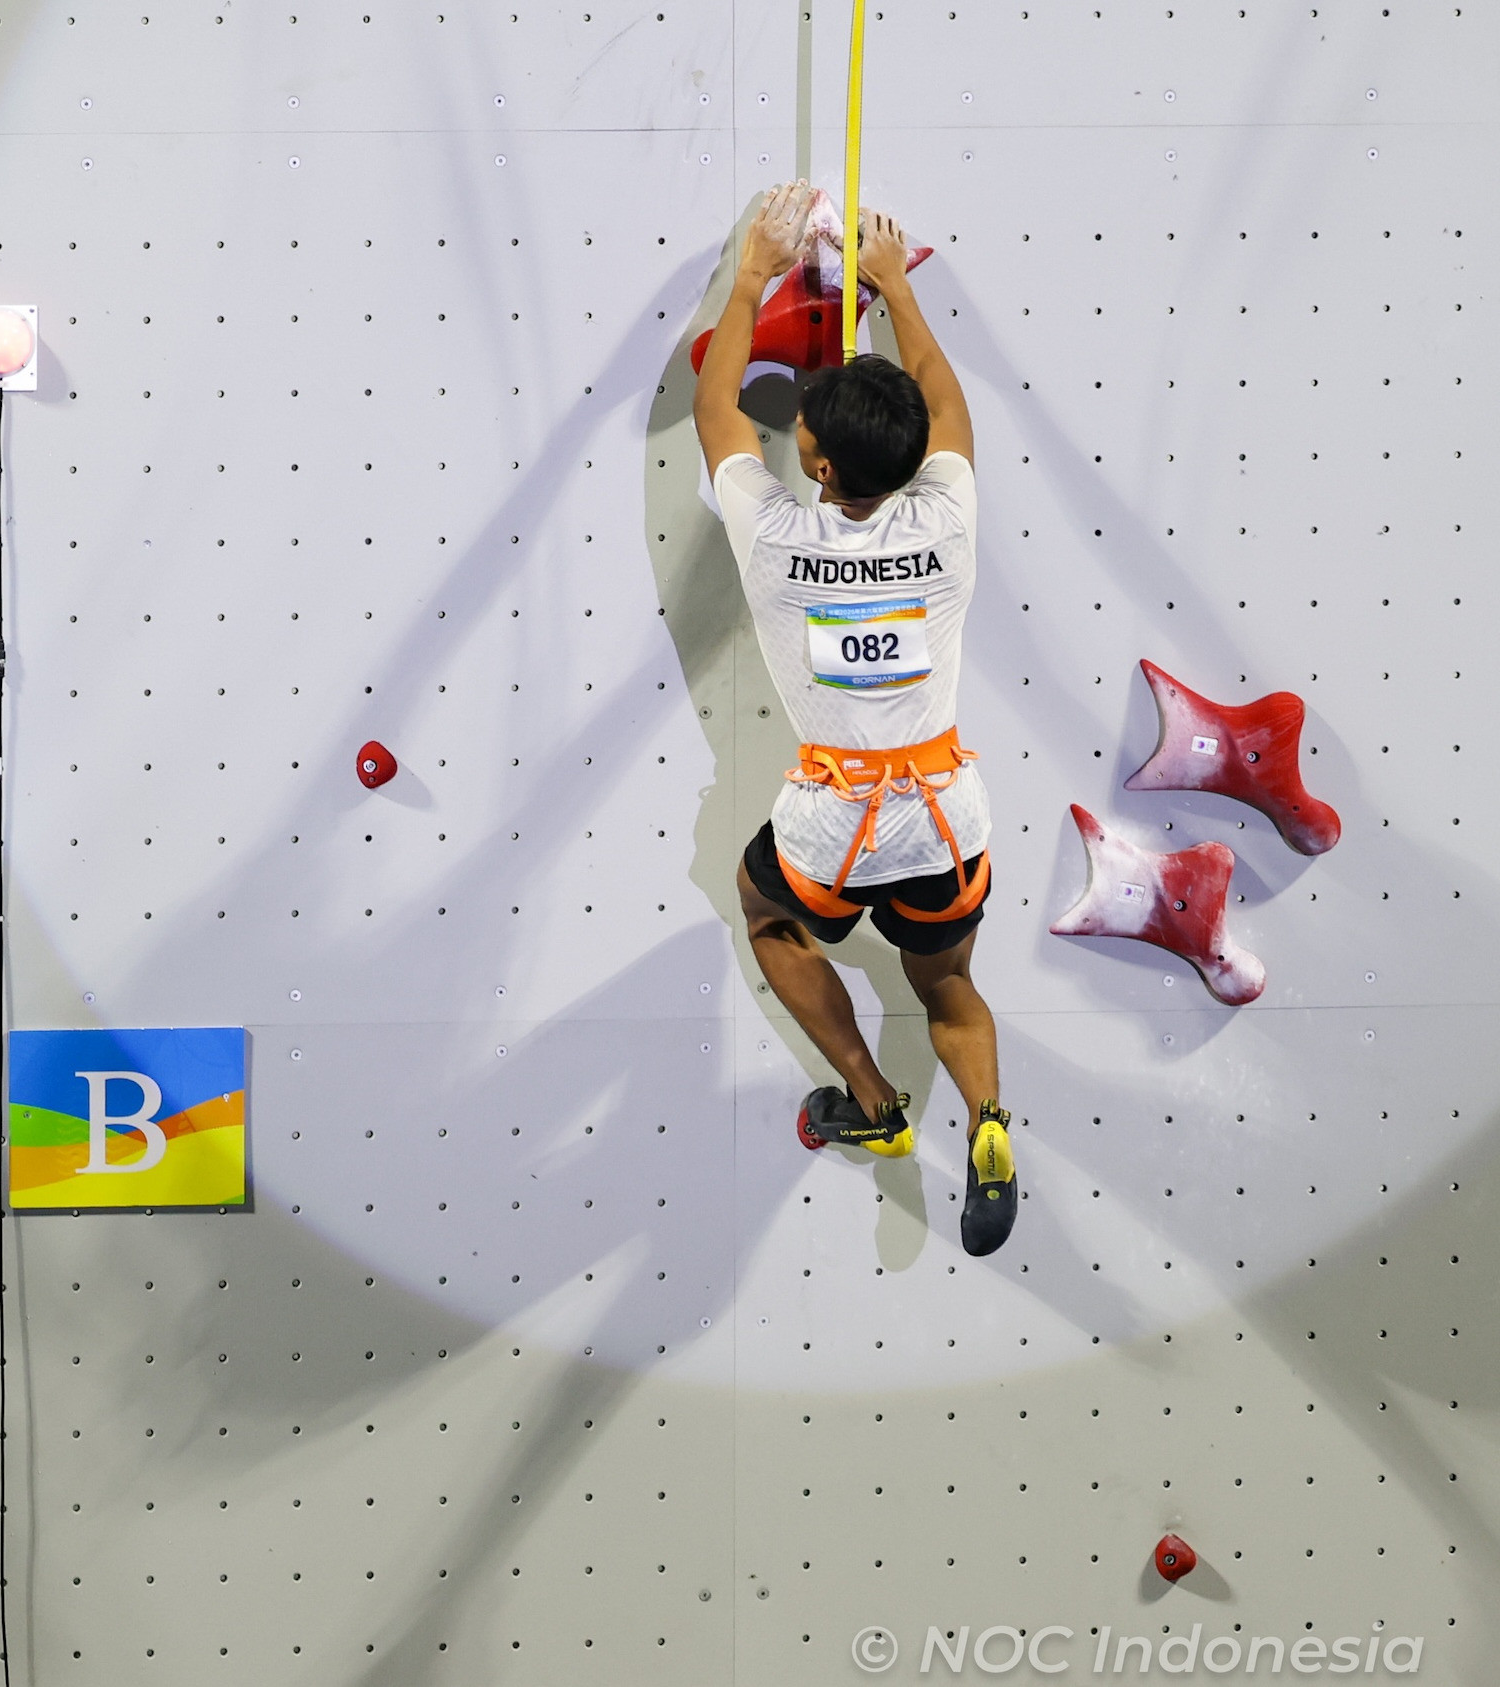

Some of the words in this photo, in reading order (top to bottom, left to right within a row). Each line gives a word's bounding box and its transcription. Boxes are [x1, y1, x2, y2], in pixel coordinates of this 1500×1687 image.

[787, 551, 943, 584] INDONESIA
[841, 633, 900, 663] 082
[75, 1071, 167, 1174] B
